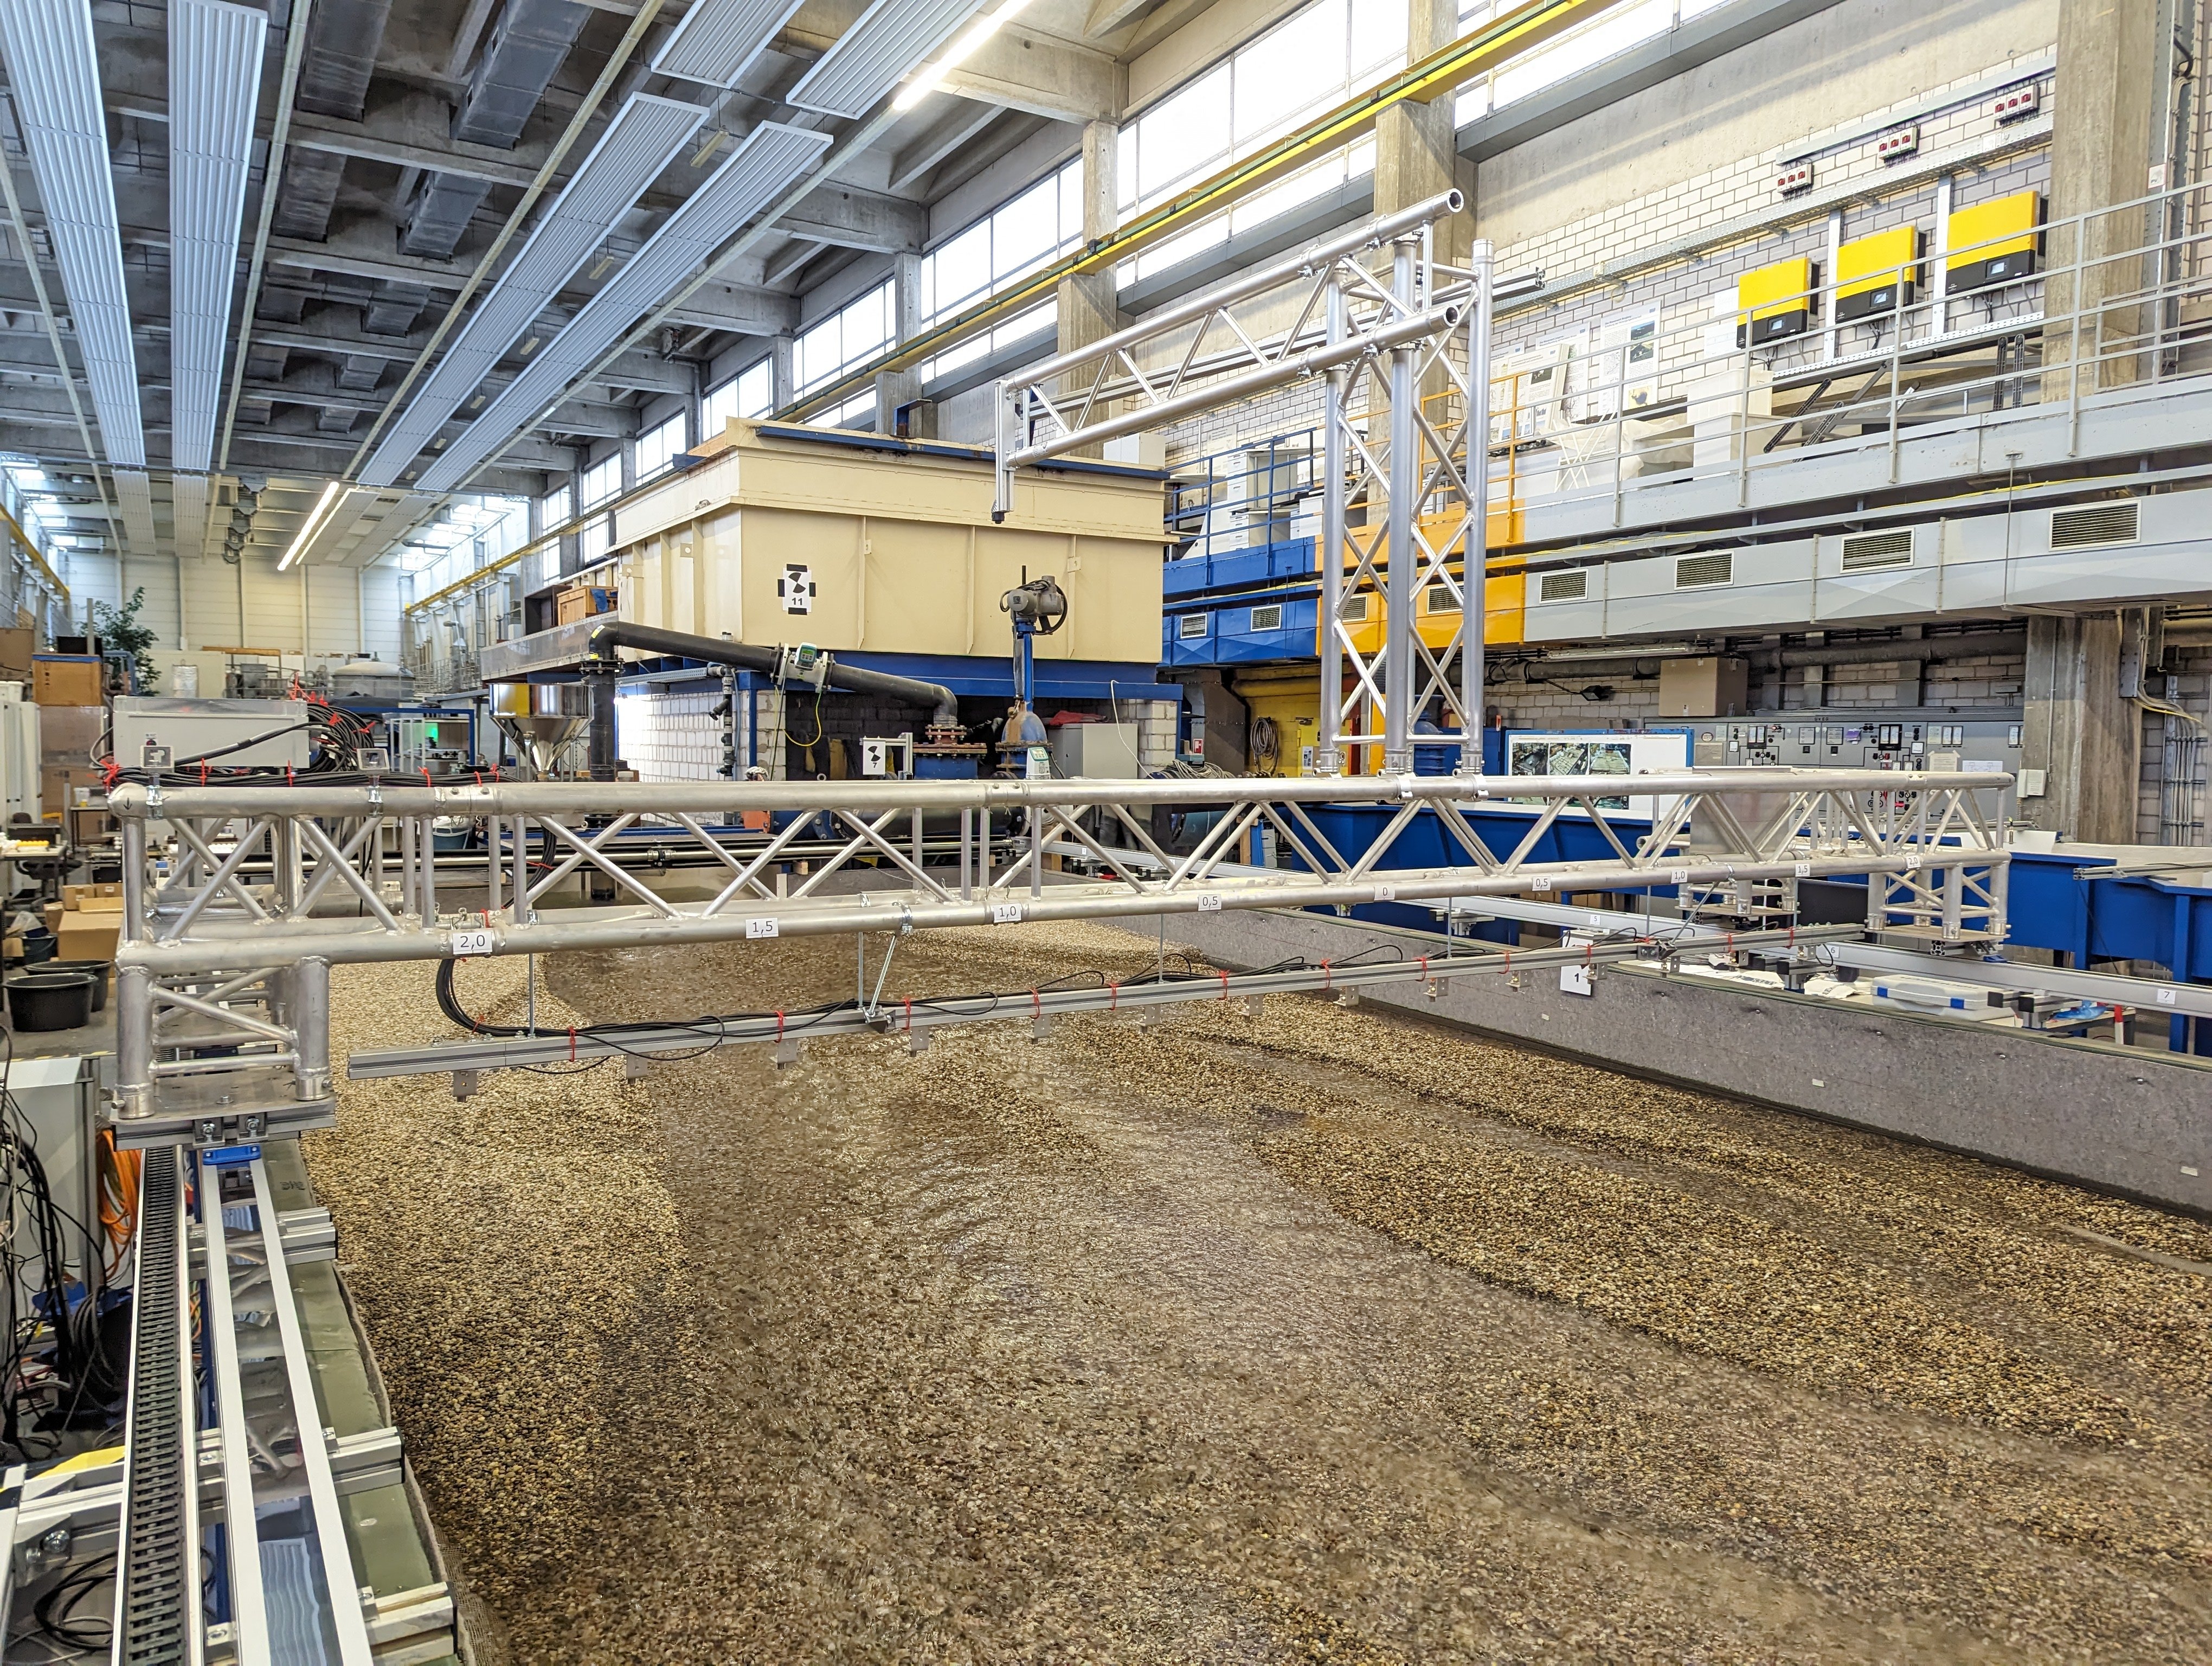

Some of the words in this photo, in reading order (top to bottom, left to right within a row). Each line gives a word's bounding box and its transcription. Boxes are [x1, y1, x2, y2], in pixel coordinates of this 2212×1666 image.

[792, 597, 802, 606] 11
[1908, 857, 1918, 866] 2,0
[1798, 865, 1808, 874] 1,5
[1674, 871, 1685, 881] 1,0
[1536, 878, 1548, 888] 0,5
[1382, 887, 1388, 896] 0
[1203, 896, 1218, 907] 0,5
[999, 906, 1017, 919] 1,0
[753, 920, 773, 934] 1,5
[460, 935, 485, 950] 2,0
[1574, 972, 1579, 983] 1
